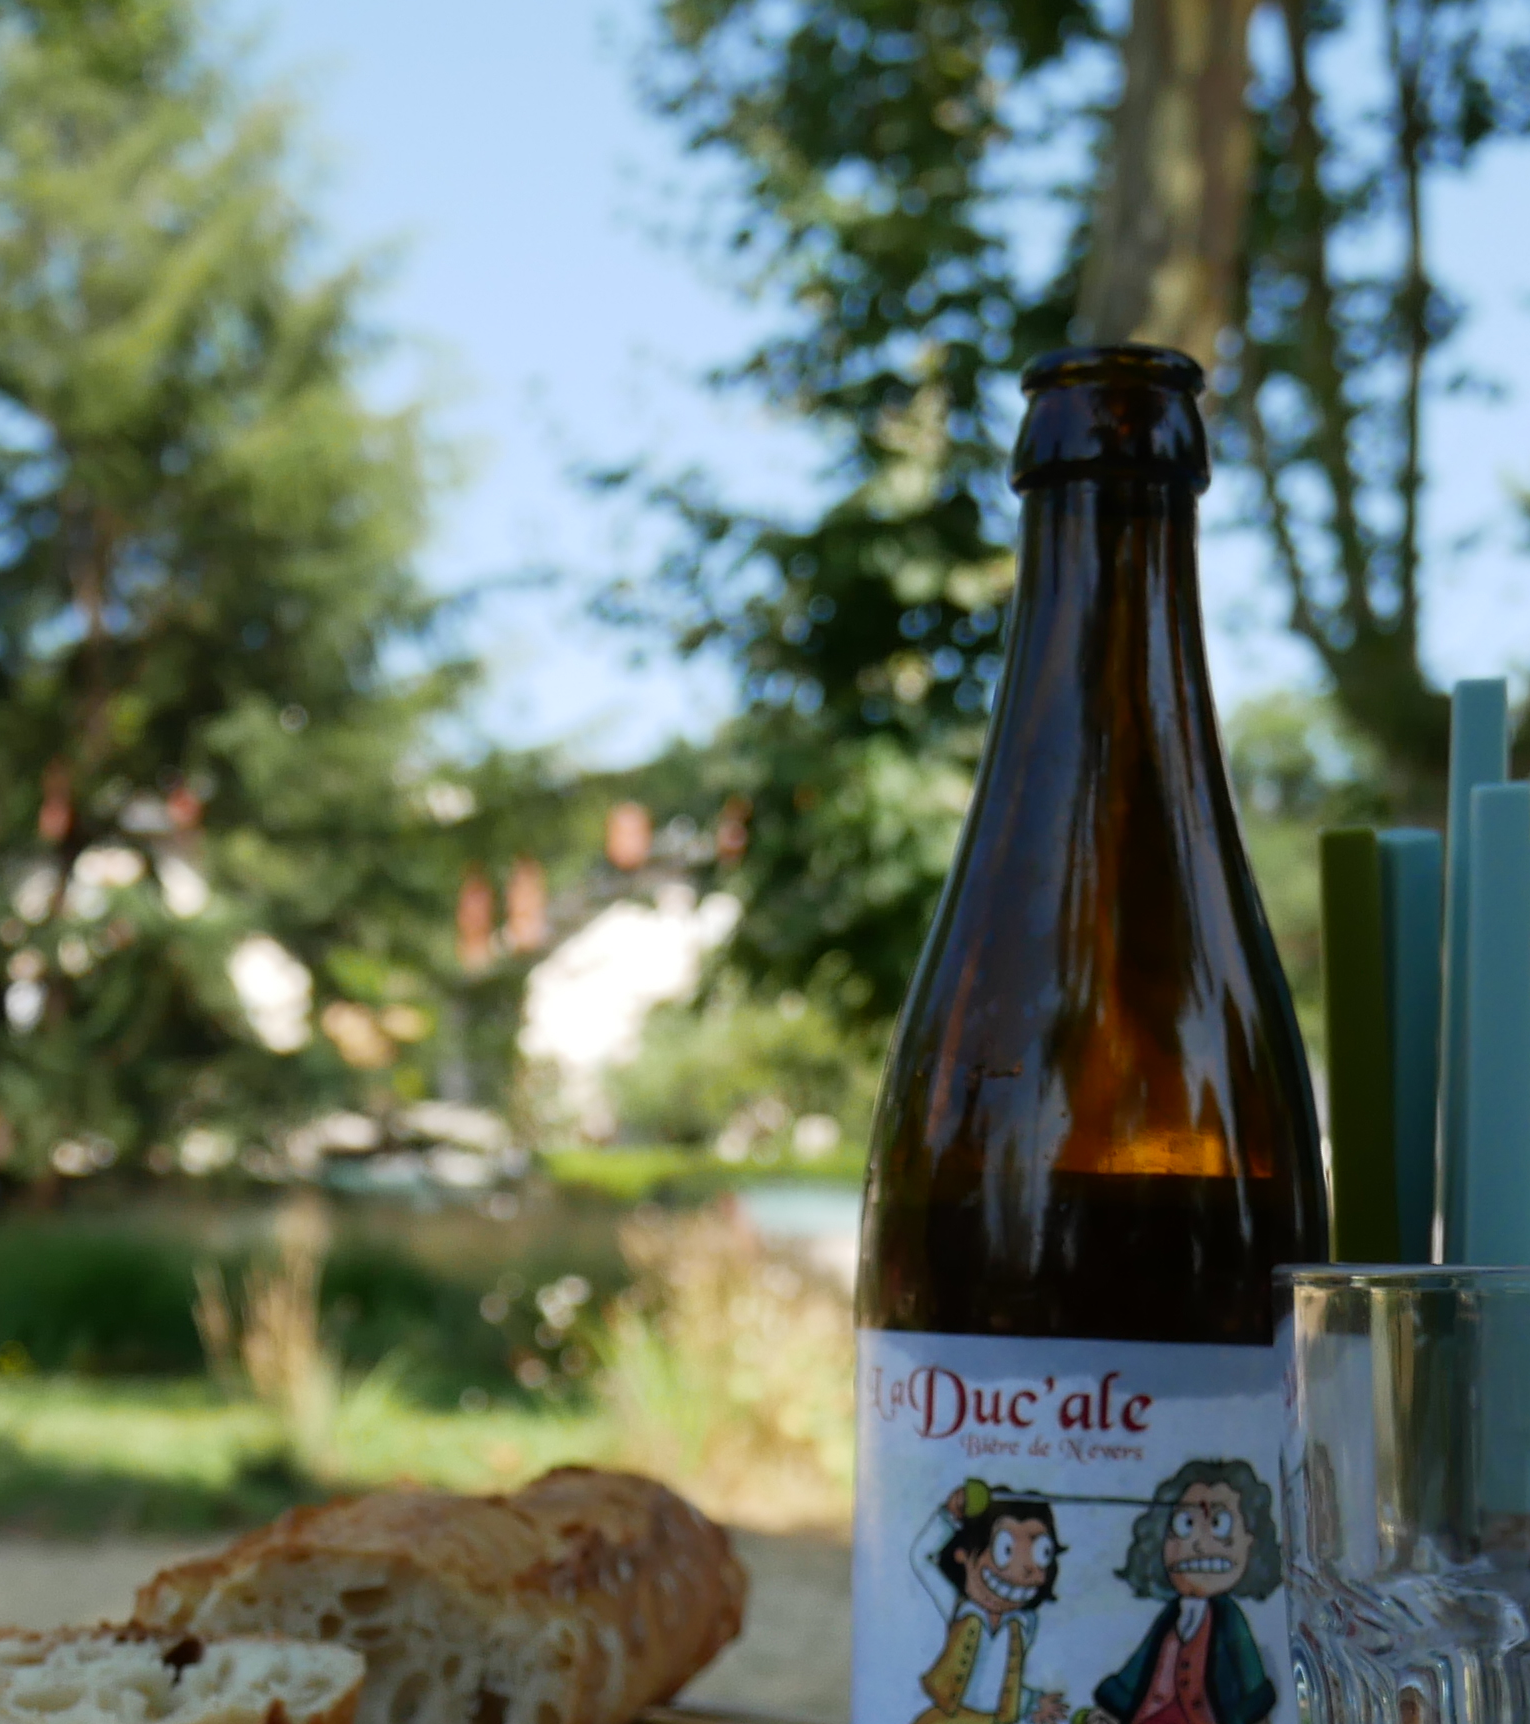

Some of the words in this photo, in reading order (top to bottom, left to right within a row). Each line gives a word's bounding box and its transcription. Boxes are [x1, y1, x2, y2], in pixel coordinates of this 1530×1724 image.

[907, 1366, 1153, 1439] Duc'ale
[1027, 1435, 1051, 1457] de
[1058, 1437, 1145, 1465] Nevers
